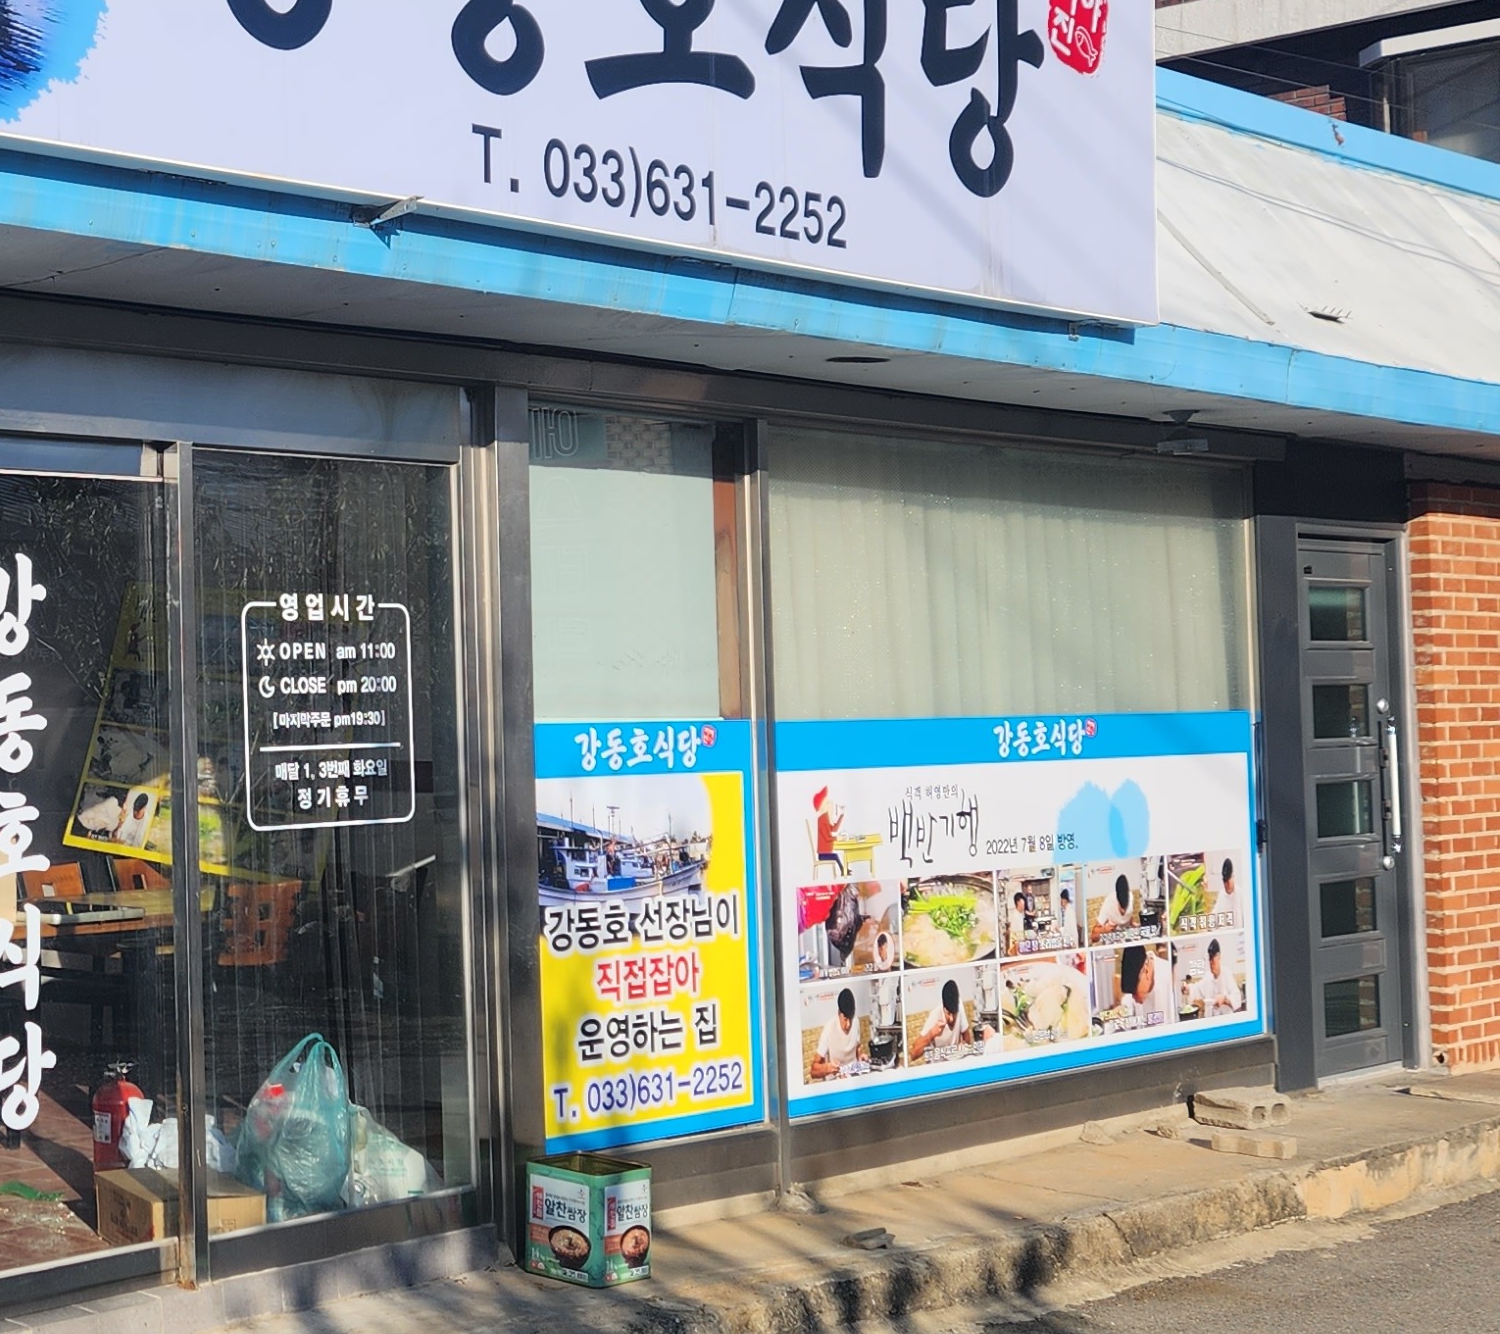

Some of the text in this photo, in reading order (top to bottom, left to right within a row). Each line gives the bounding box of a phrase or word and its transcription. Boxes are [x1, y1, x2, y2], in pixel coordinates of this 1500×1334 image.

[472, 124, 847, 248] T. 033)631-2252
[279, 592, 375, 622] 영업시간
[279, 642, 396, 660] OPEN am 11:00
[280, 675, 397, 696] CLOSE pm 20:00
[575, 725, 701, 771] 강동호식당
[993, 718, 1086, 758] 강동호식당
[274, 761, 300, 781] 매달
[318, 759, 351, 779] 3번째
[352, 758, 388, 778] 화요일
[297, 785, 369, 810] 정기휴무
[986, 835, 1019, 855] 2022년
[1021, 835, 1036, 853] 7월
[1039, 834, 1054, 852] 8일
[549, 894, 739, 952] 강동호 선장님이
[597, 952, 700, 1001] 직접잡아
[578, 1004, 718, 1062] 운영하는 집
[554, 1062, 743, 1118] T. 033)631-2252
[544, 1197, 587, 1224] 알찬쌈장
